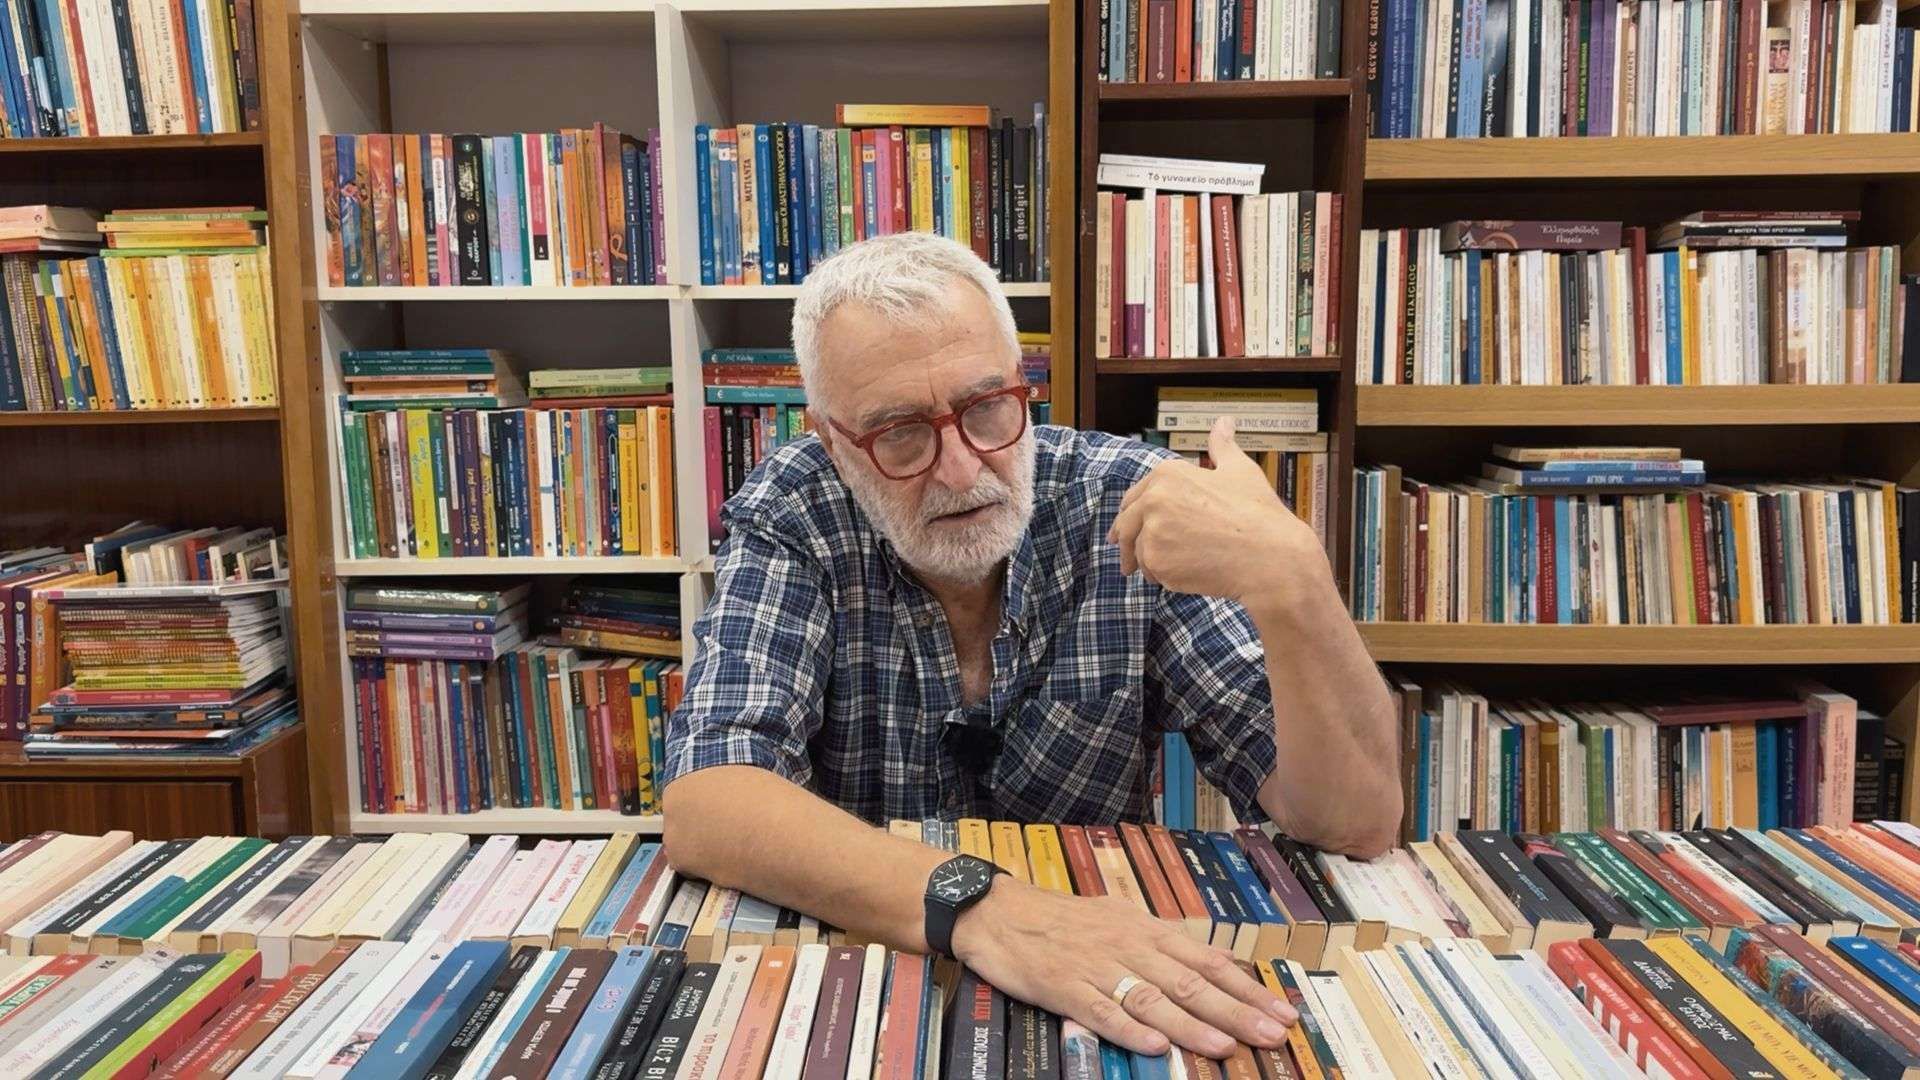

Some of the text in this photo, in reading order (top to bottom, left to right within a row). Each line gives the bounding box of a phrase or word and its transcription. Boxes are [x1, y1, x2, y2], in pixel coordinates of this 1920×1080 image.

[743, 158, 752, 202] ΜΑΤΙΑΝΤΑ
[1208, 175, 1255, 188] πρόβλημα
[1014, 183, 1027, 241] ghostgirl
[1404, 321, 1413, 365] ΠΑΤΗΡ
[1404, 369, 1412, 378] Ο
